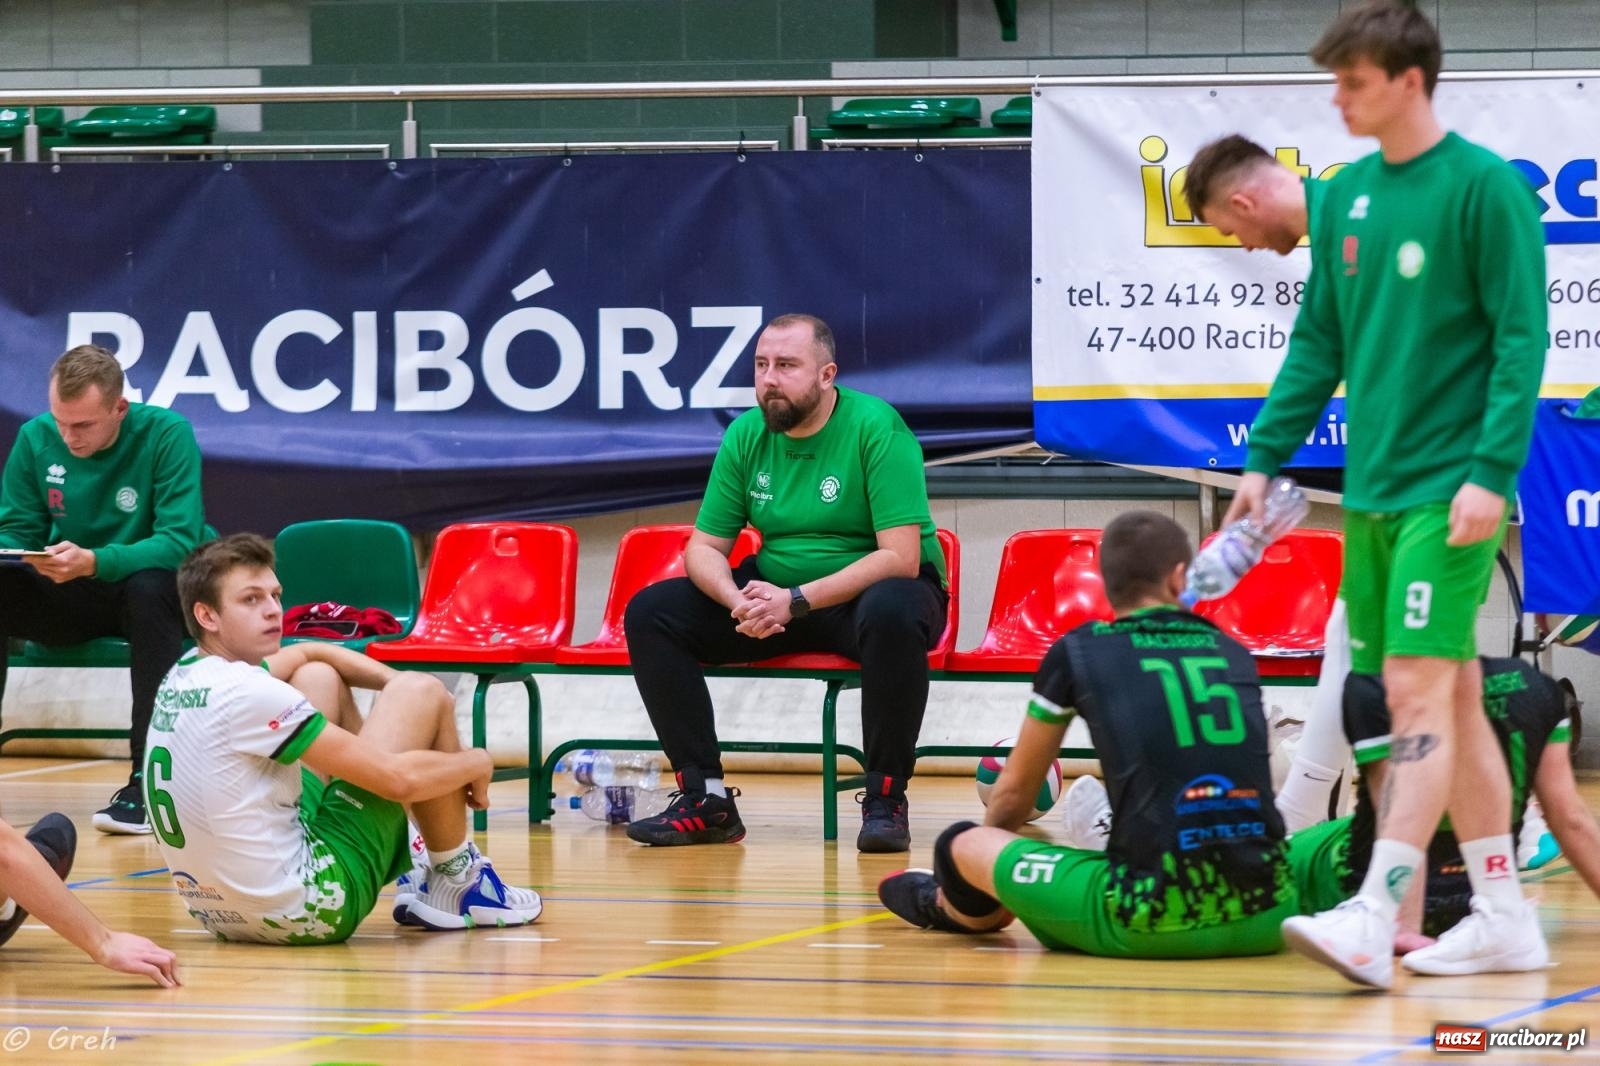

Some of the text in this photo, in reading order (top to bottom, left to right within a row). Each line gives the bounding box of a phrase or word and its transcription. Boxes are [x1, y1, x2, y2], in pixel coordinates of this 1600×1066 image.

[1067, 281, 1111, 307] tel.
[1120, 283, 1155, 309] 32
[1165, 282, 1221, 308] 414
[1231, 283, 1265, 308] 92
[65, 268, 764, 413] RACIBÓRZ
[1087, 326, 1196, 353] 47-400
[1206, 323, 1286, 350] Racib
[1403, 580, 1433, 629] 9
[1139, 656, 1247, 748] 15
[1011, 852, 1065, 884] 15
[1486, 854, 1509, 873] R
